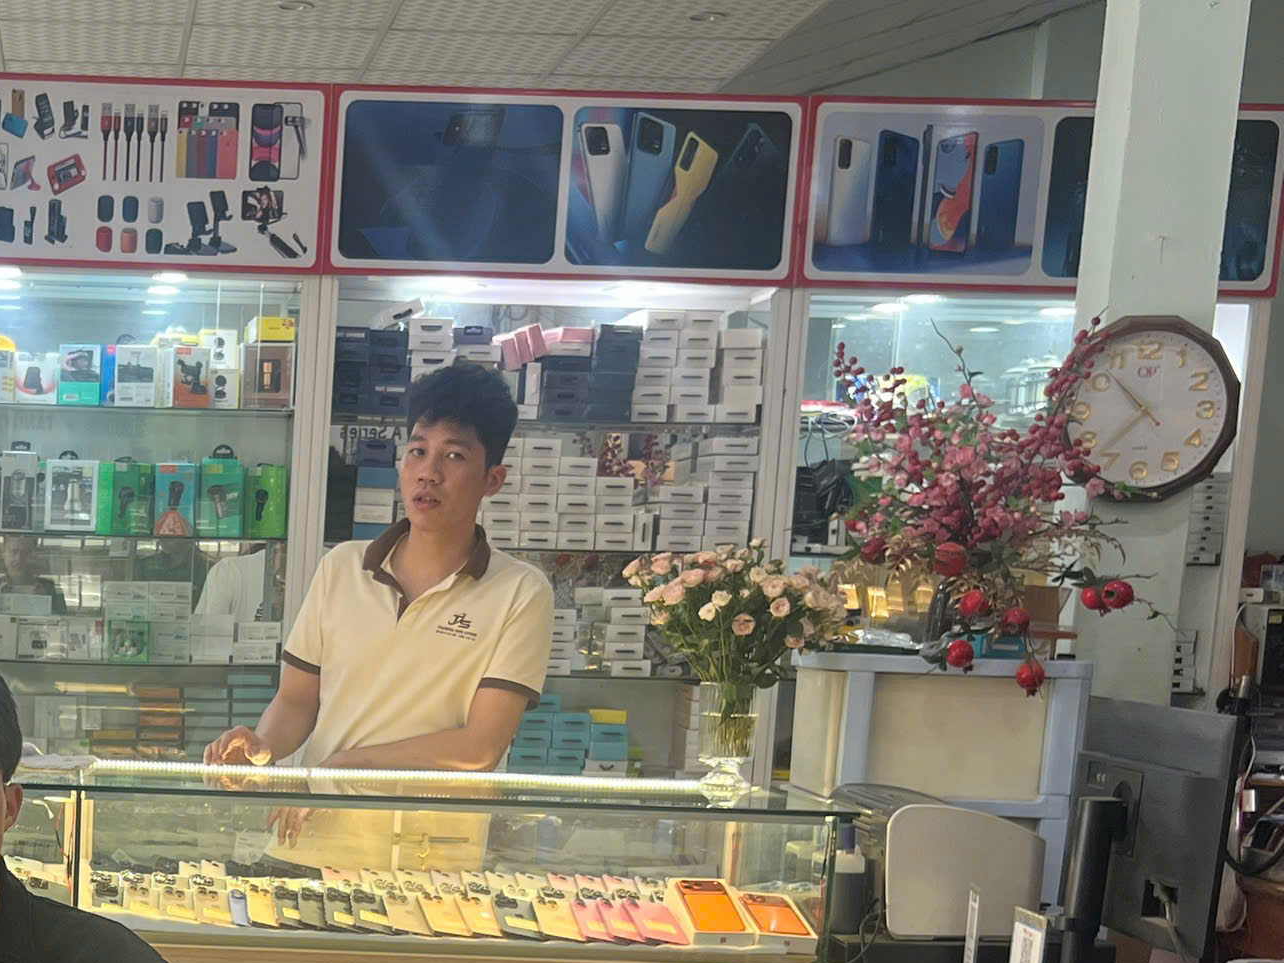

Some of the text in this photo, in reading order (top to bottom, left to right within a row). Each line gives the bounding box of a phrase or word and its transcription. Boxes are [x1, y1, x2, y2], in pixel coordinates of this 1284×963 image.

[1189, 370, 1210, 392] 2
[1195, 400, 1215, 420] 3
[1184, 430, 1204, 448] 4
[1100, 452, 1120, 472] 7
[1129, 461, 1149, 481] 6
[1161, 451, 1181, 472] 5
